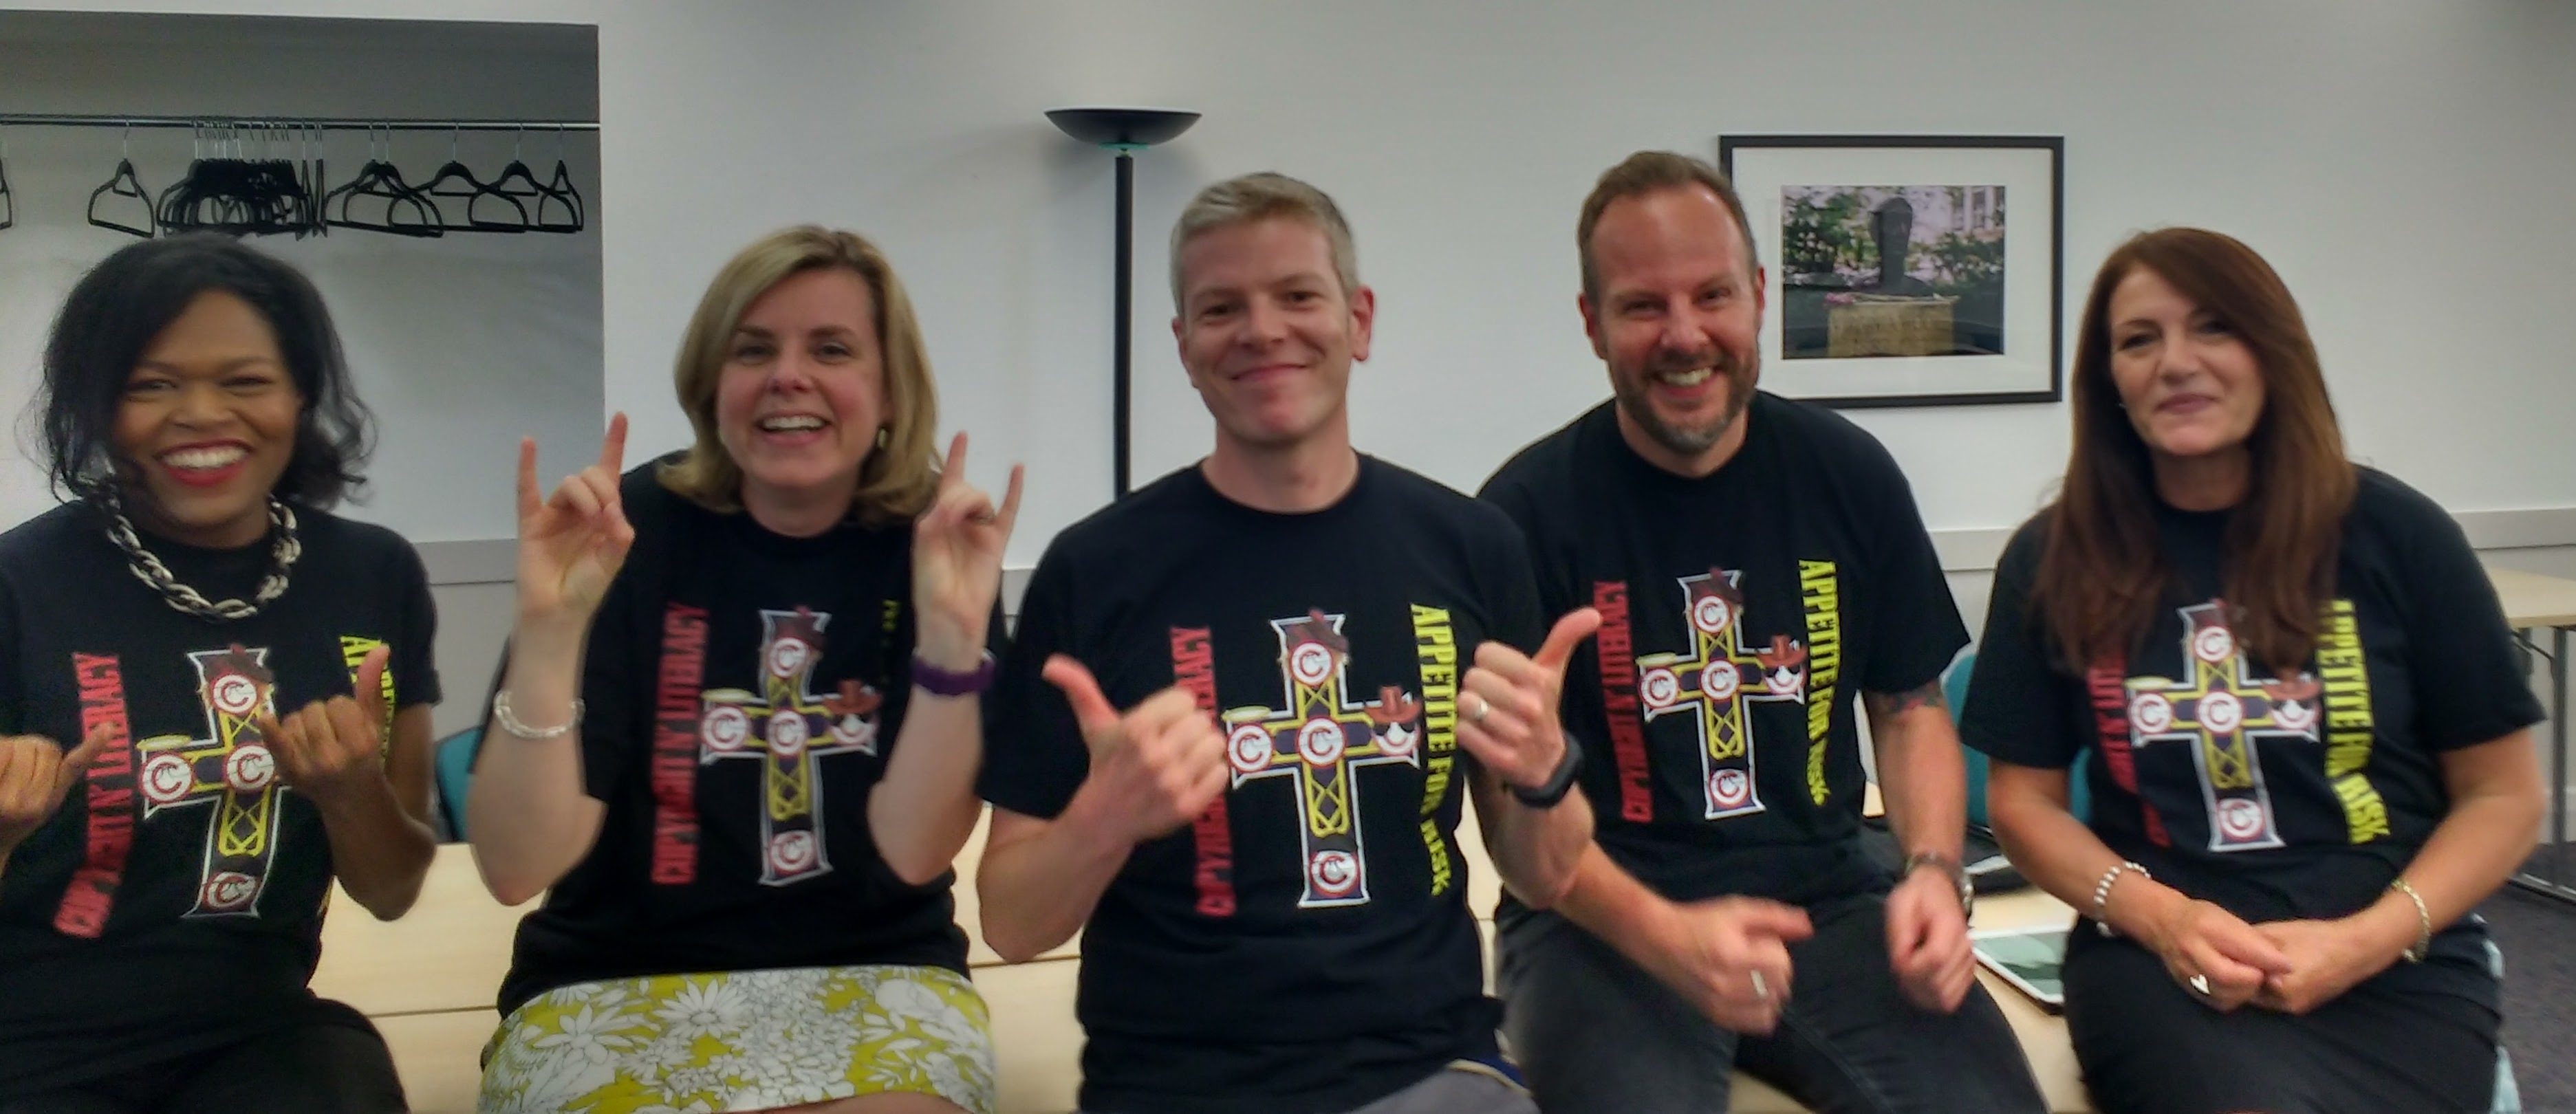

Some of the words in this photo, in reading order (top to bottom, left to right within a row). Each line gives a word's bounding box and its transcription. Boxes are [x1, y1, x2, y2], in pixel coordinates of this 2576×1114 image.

[654, 602, 709, 721] LITERACY
[1410, 602, 1458, 752] APPETITE
[1593, 580, 1634, 686] LITERACY
[1797, 559, 1841, 688] APPETITE
[1808, 686, 1835, 741] FOR
[2324, 731, 2374, 779] FOR
[650, 757, 700, 885] COPYRIGHT
[1420, 754, 1454, 816] FOR
[1606, 713, 1654, 823] COPYRIGHT
[1806, 736, 1832, 807] RISK
[2330, 772, 2392, 846] RISK
[54, 813, 133, 938] COPYRIGHT
[1193, 794, 1237, 917] COPYRIGH
[1420, 818, 1451, 897] RISK
